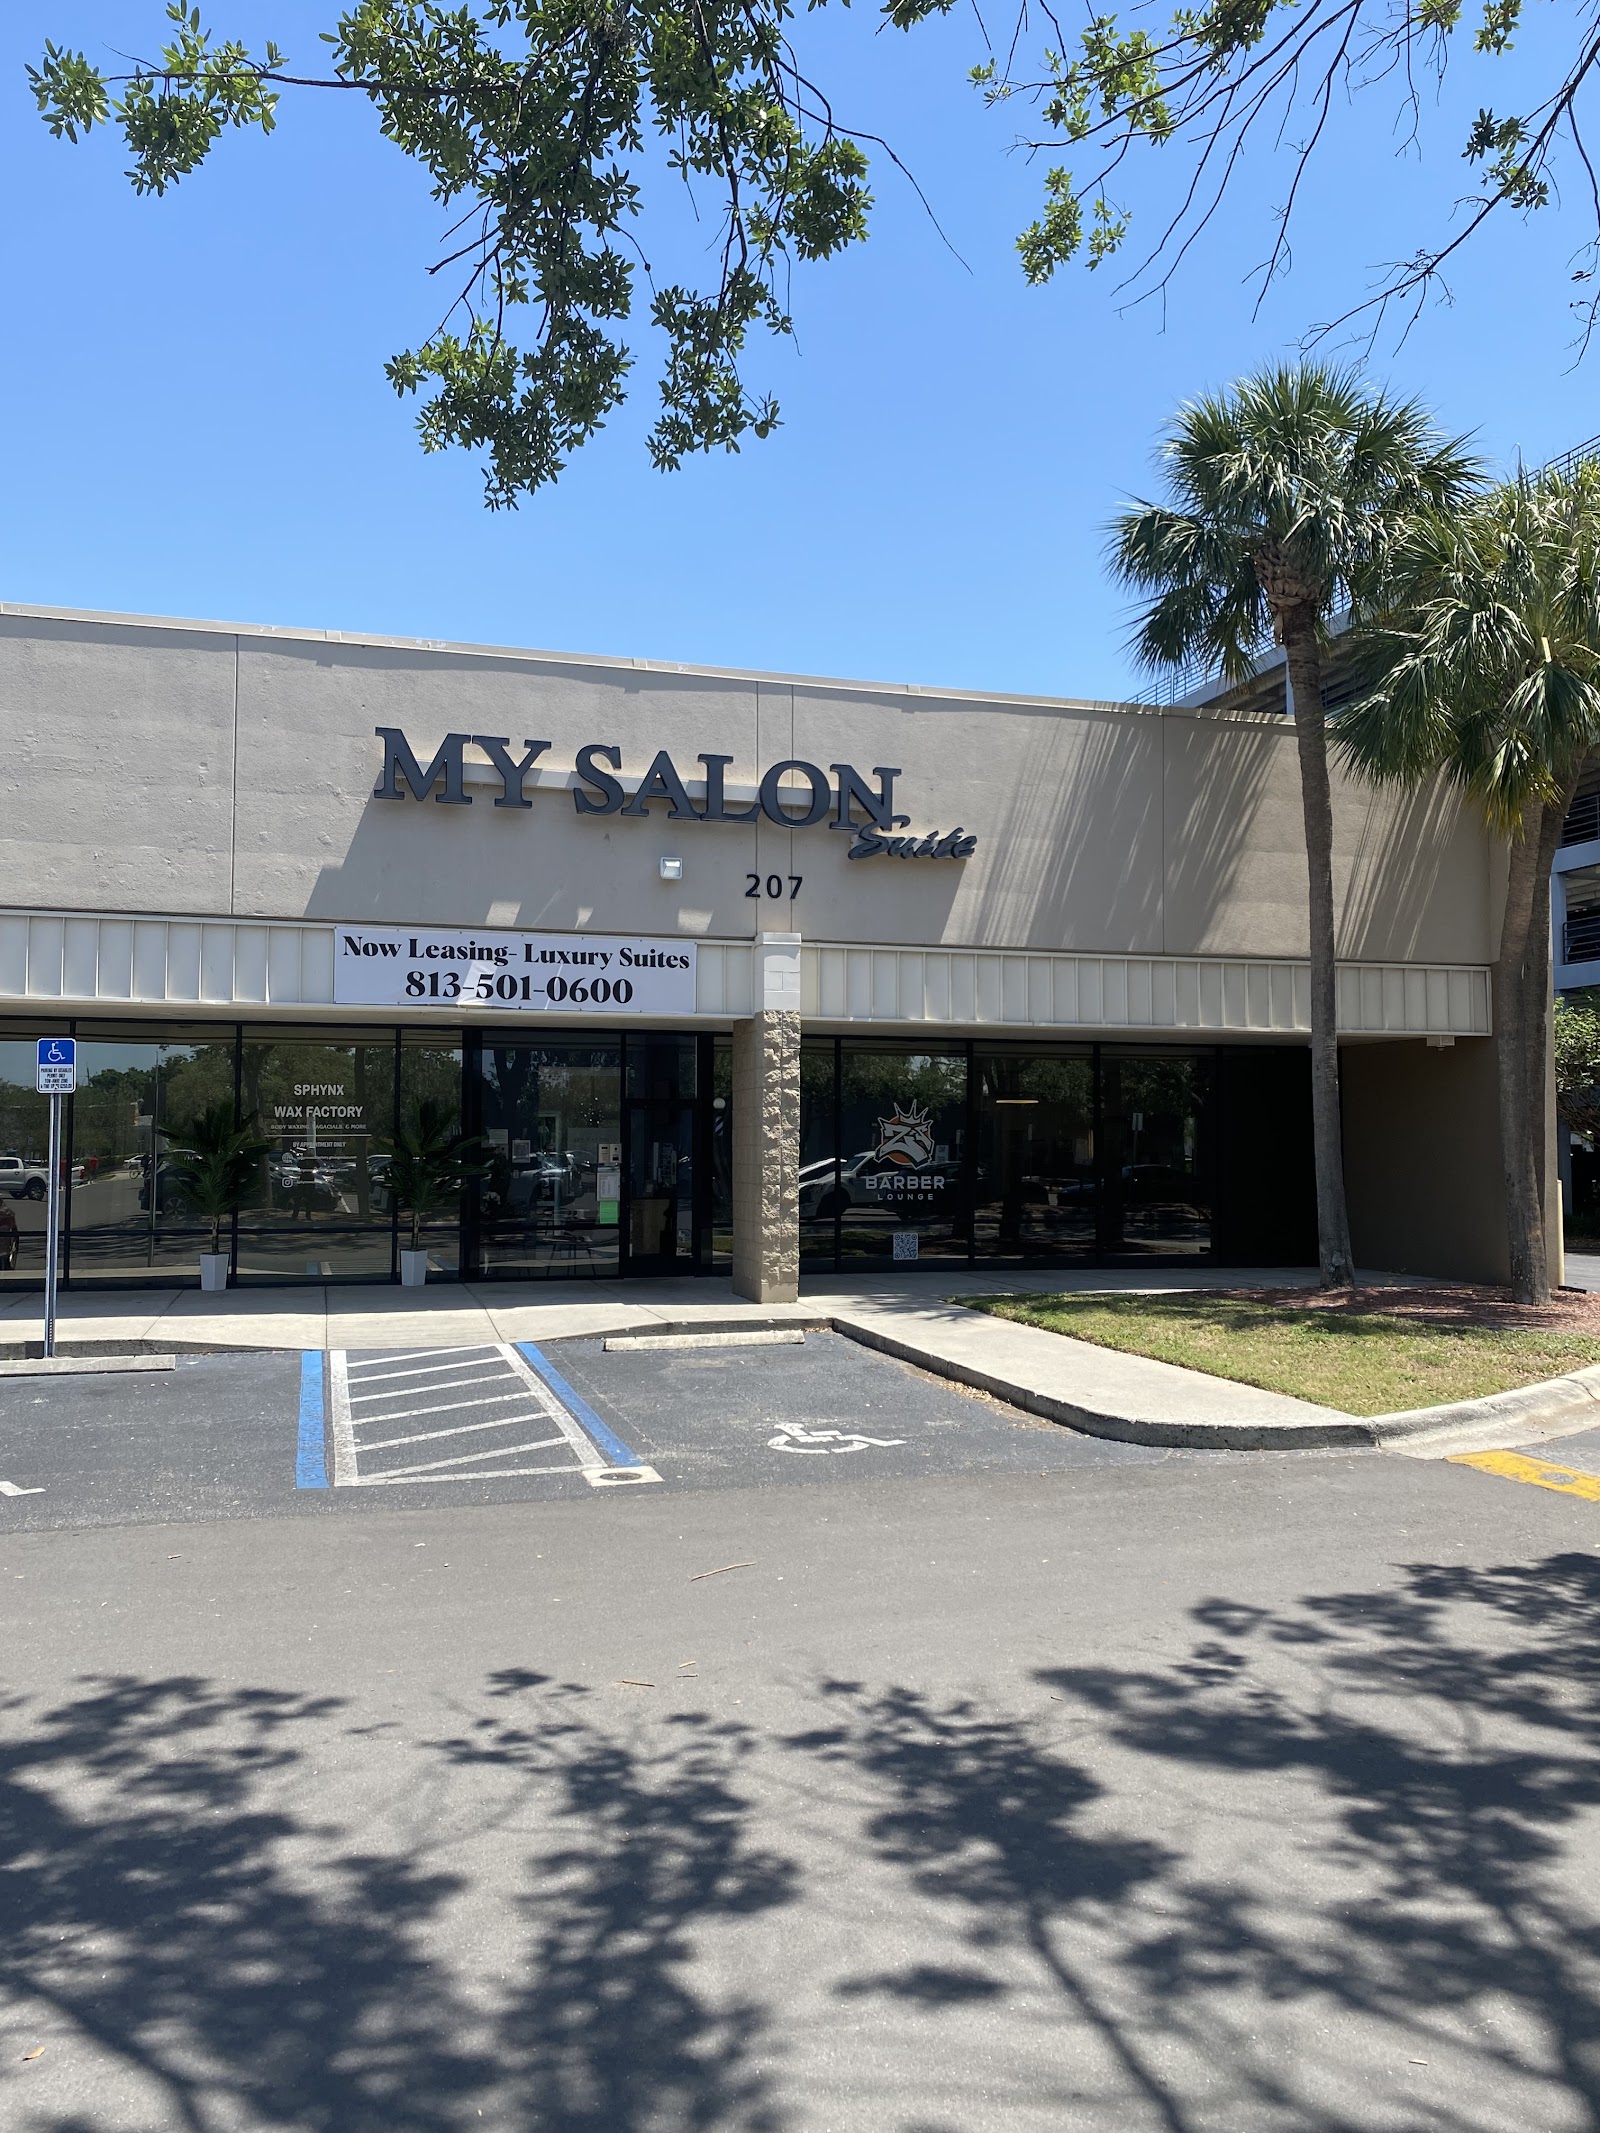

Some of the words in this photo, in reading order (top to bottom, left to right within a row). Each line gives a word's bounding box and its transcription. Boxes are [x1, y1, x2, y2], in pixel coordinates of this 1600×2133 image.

[374, 727, 552, 809] MY
[573, 744, 902, 832] SALON
[848, 815, 978, 860] Suite
[745, 873, 804, 901] 207
[343, 935, 402, 958] Now
[523, 943, 613, 970] Luxury
[619, 947, 690, 969] Suites
[405, 969, 634, 1004] 813-501-0600
[293, 1084, 345, 1096] SPHYNX
[274, 1105, 303, 1118] WAX
[306, 1105, 363, 1118] FACTORY
[865, 1175, 945, 1190] BARBER
[877, 1193, 934, 1201] LOUNGE
